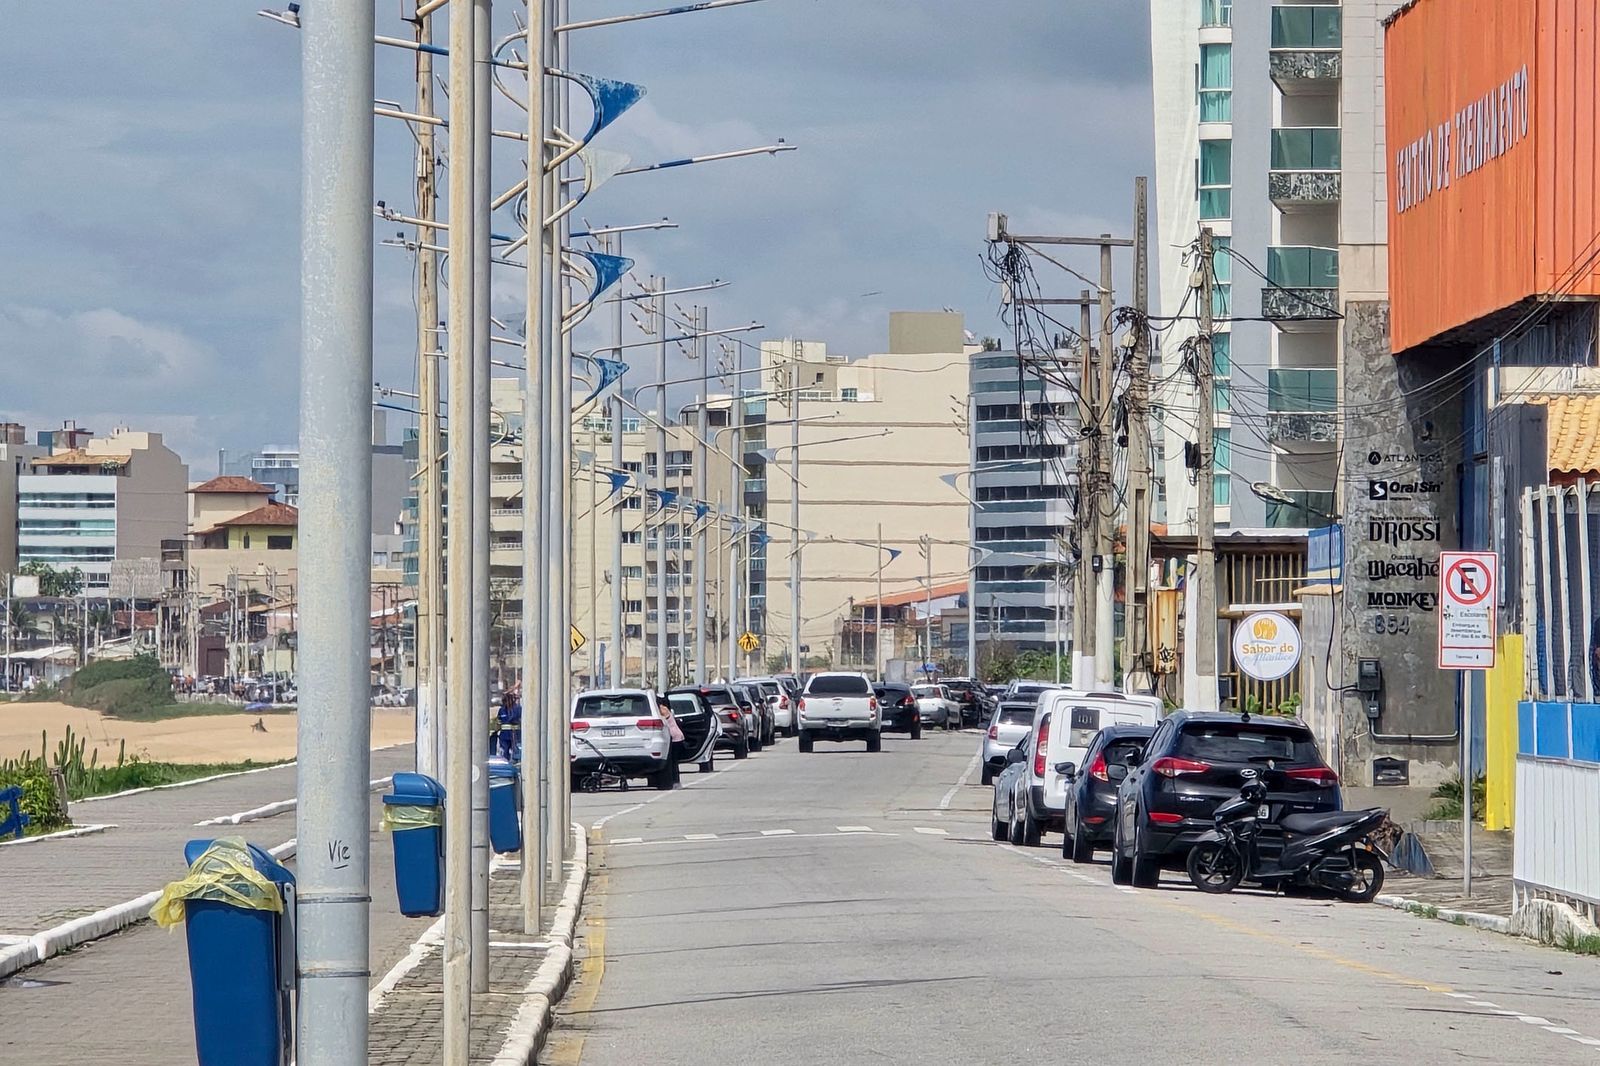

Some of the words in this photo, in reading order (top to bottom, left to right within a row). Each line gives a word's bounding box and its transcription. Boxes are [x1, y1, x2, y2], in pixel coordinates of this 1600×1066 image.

[1437, 121, 1451, 191] DE
[1455, 63, 1528, 179] TREINAMENTO
[1390, 482, 1419, 493] Oral
[1420, 482, 1441, 493] Sin
[1370, 522, 1441, 547] D'ROSSI
[1368, 592, 1440, 611] MONKEY
[1242, 643, 1276, 654] Sabor
[1280, 643, 1295, 653] do
